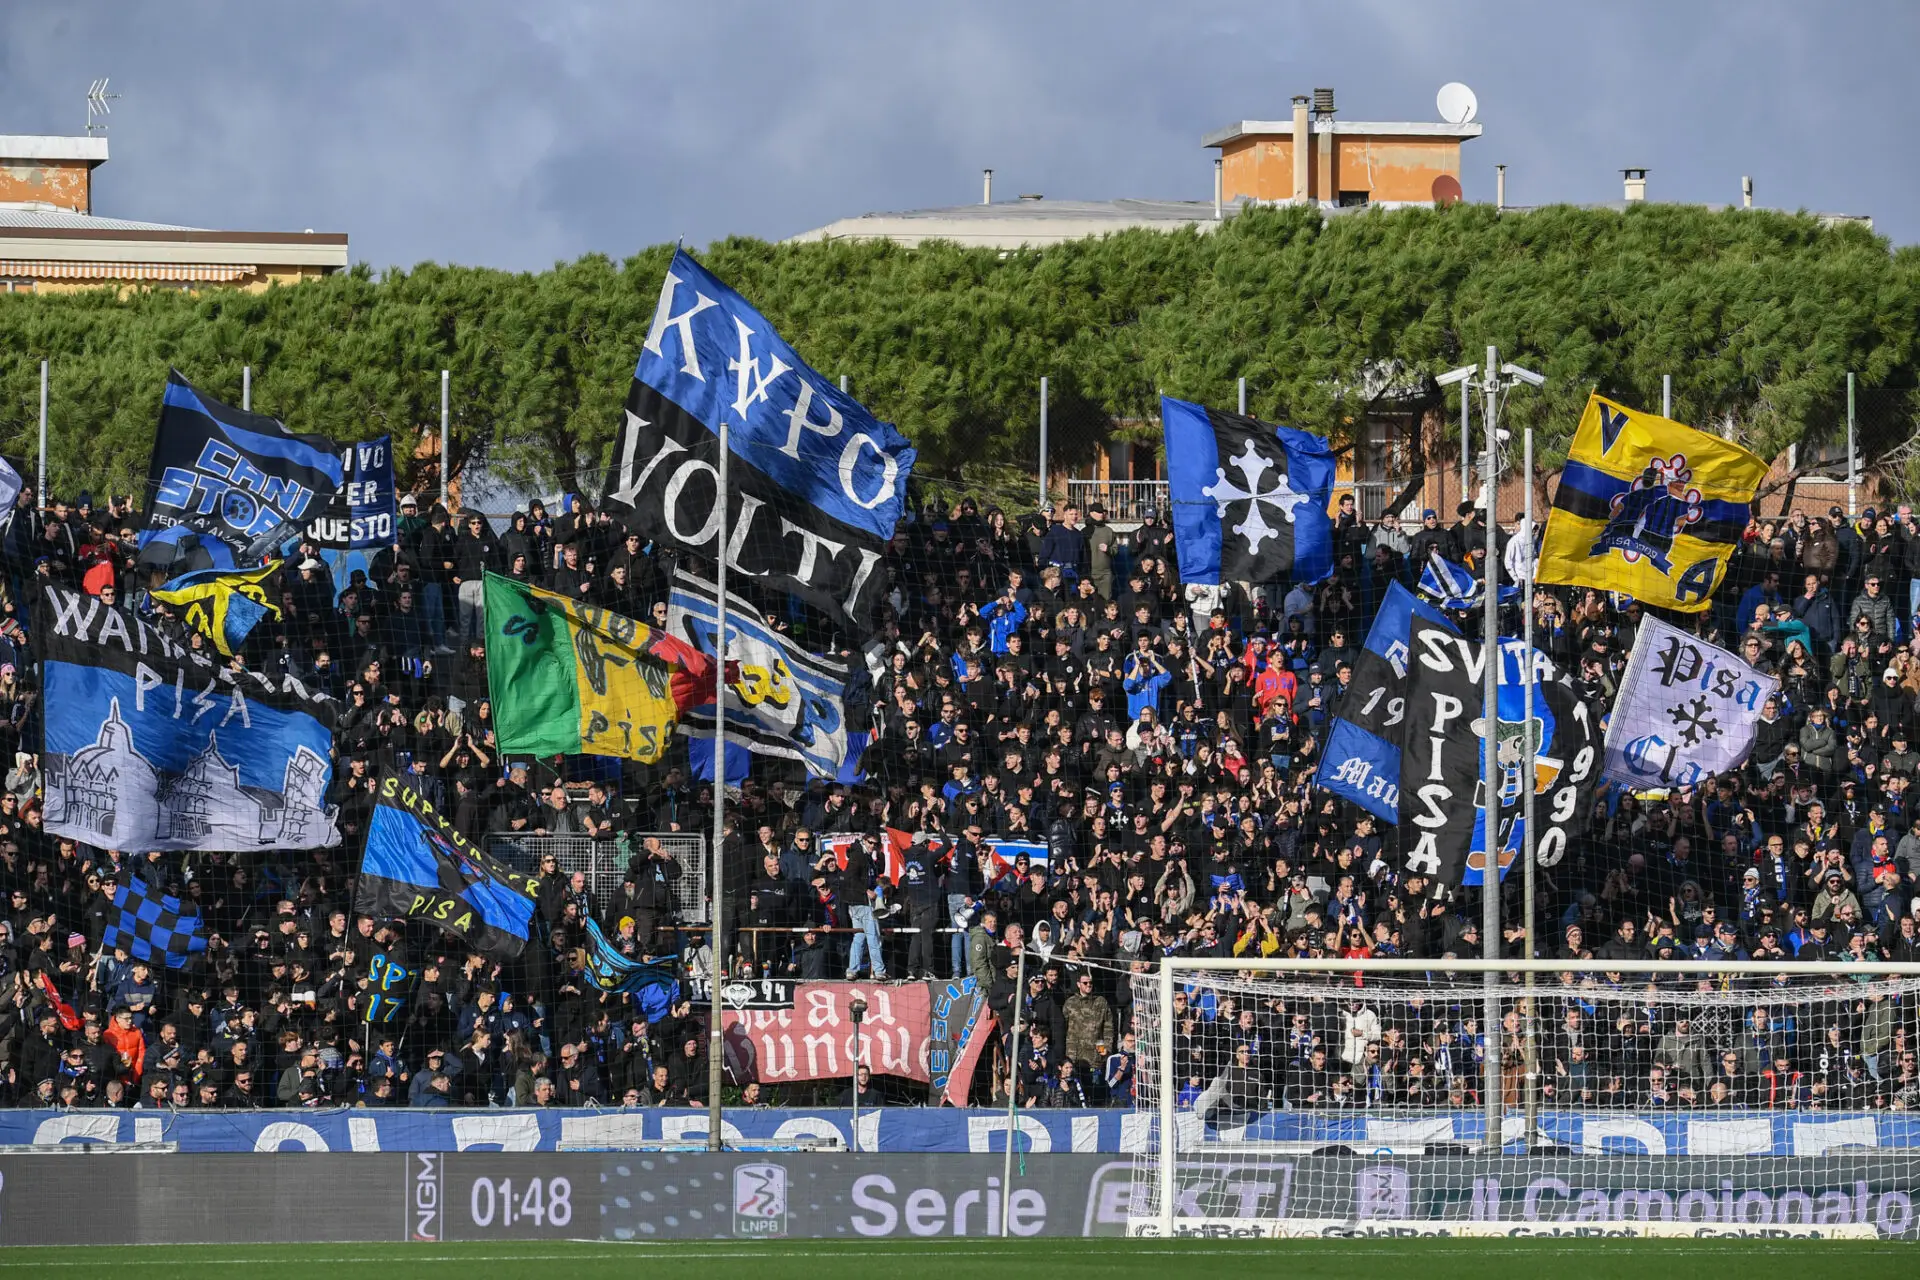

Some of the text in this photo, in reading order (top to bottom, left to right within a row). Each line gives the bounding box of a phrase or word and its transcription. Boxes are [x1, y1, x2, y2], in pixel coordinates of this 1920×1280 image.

[196, 438, 314, 519] CANI
[342, 443, 386, 472] IVO
[307, 511, 391, 543] QUESTO
[609, 409, 882, 623] VOLTI
[136, 661, 251, 729] PISA
[1651, 636, 1762, 711] Pisa
[1404, 691, 1463, 875] PISA
[408, 895, 472, 932] PISA
[762, 981, 786, 1002] 94
[471, 1177, 572, 1227] 01:48
[741, 1220, 778, 1233] LNPB
[851, 1174, 1046, 1237] Serie
[1524, 1177, 1913, 1233] Campionato
[1135, 1224, 1265, 1238] GldBet
